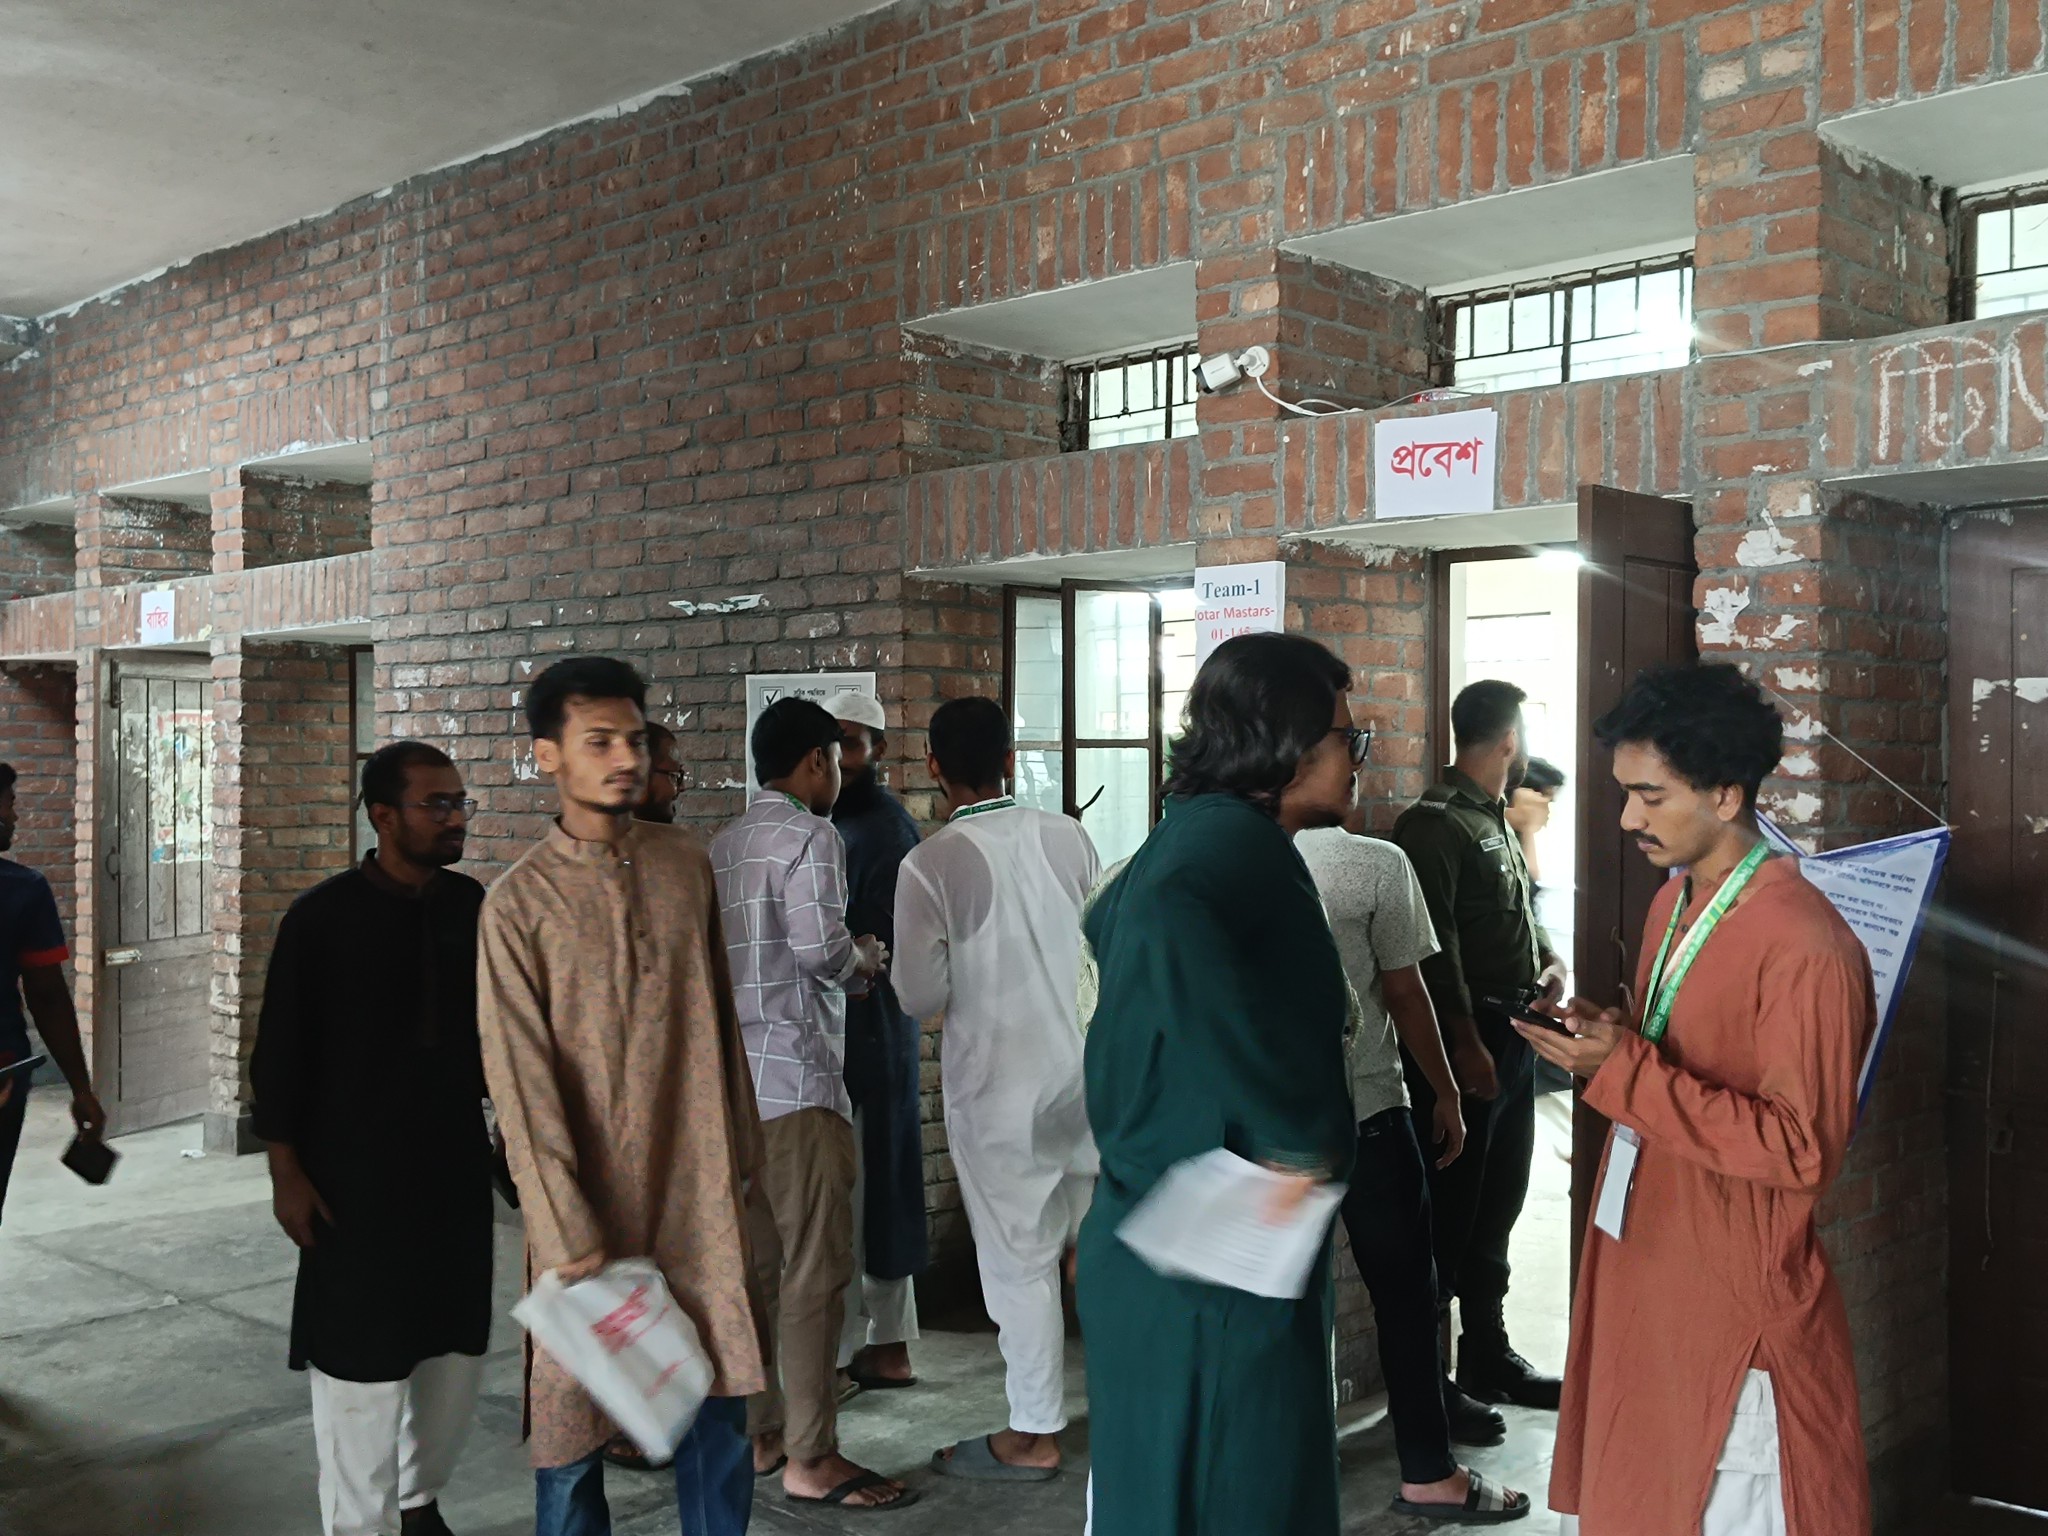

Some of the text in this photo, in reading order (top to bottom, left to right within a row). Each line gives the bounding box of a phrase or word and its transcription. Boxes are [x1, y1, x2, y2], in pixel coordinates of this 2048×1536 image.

[1391, 437, 1484, 480] প্রবেশ
[1202, 579, 1260, 599] Team-1
[146, 606, 169, 629] বাহির
[1195, 610, 1220, 621] otar
